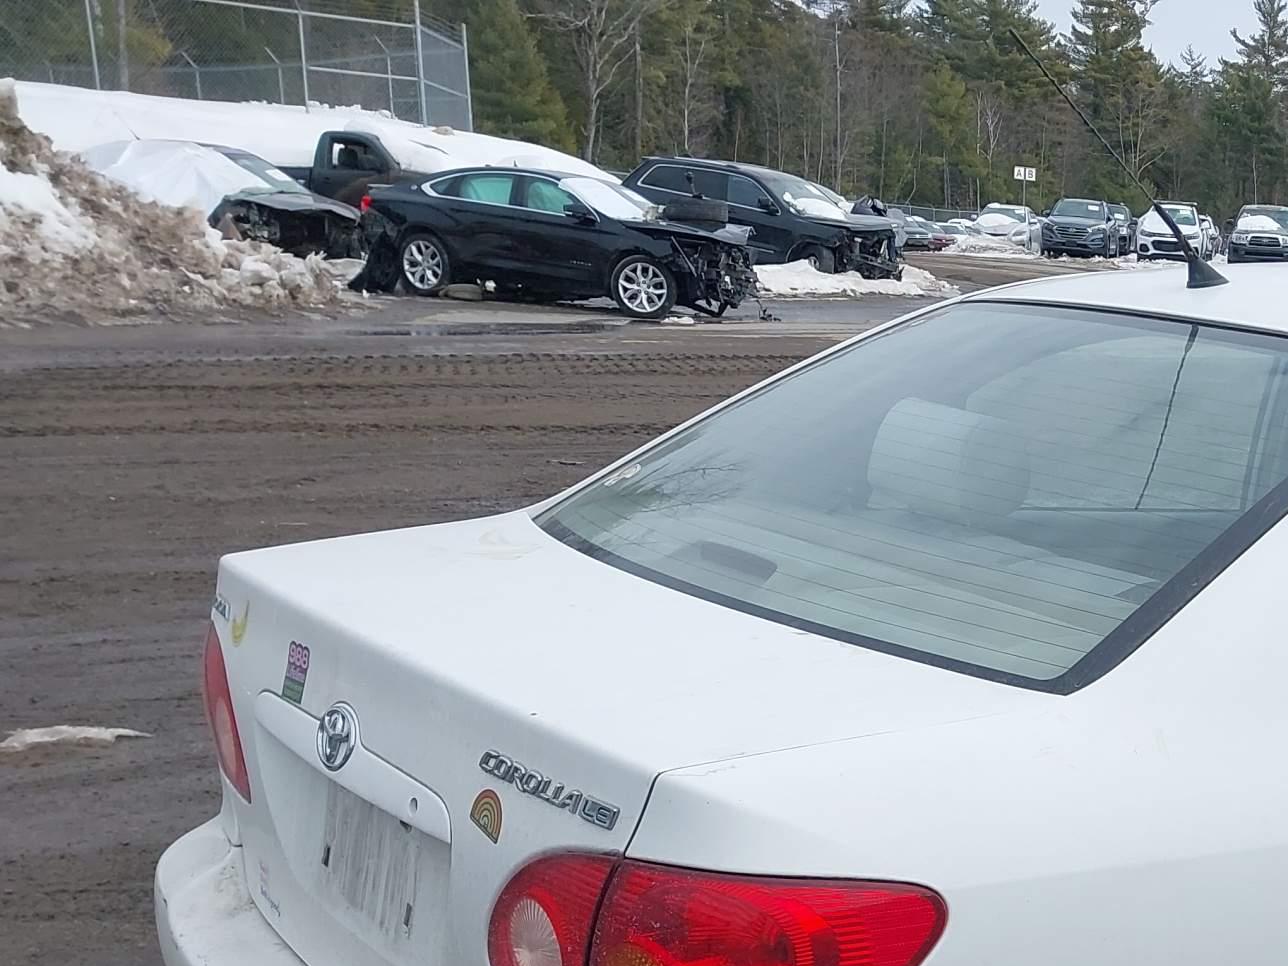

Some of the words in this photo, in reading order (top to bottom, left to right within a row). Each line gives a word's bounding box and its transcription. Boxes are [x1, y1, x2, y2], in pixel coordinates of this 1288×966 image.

[289, 642, 309, 669] 988
[479, 749, 583, 815] COROLLA
[580, 797, 617, 829] LE
